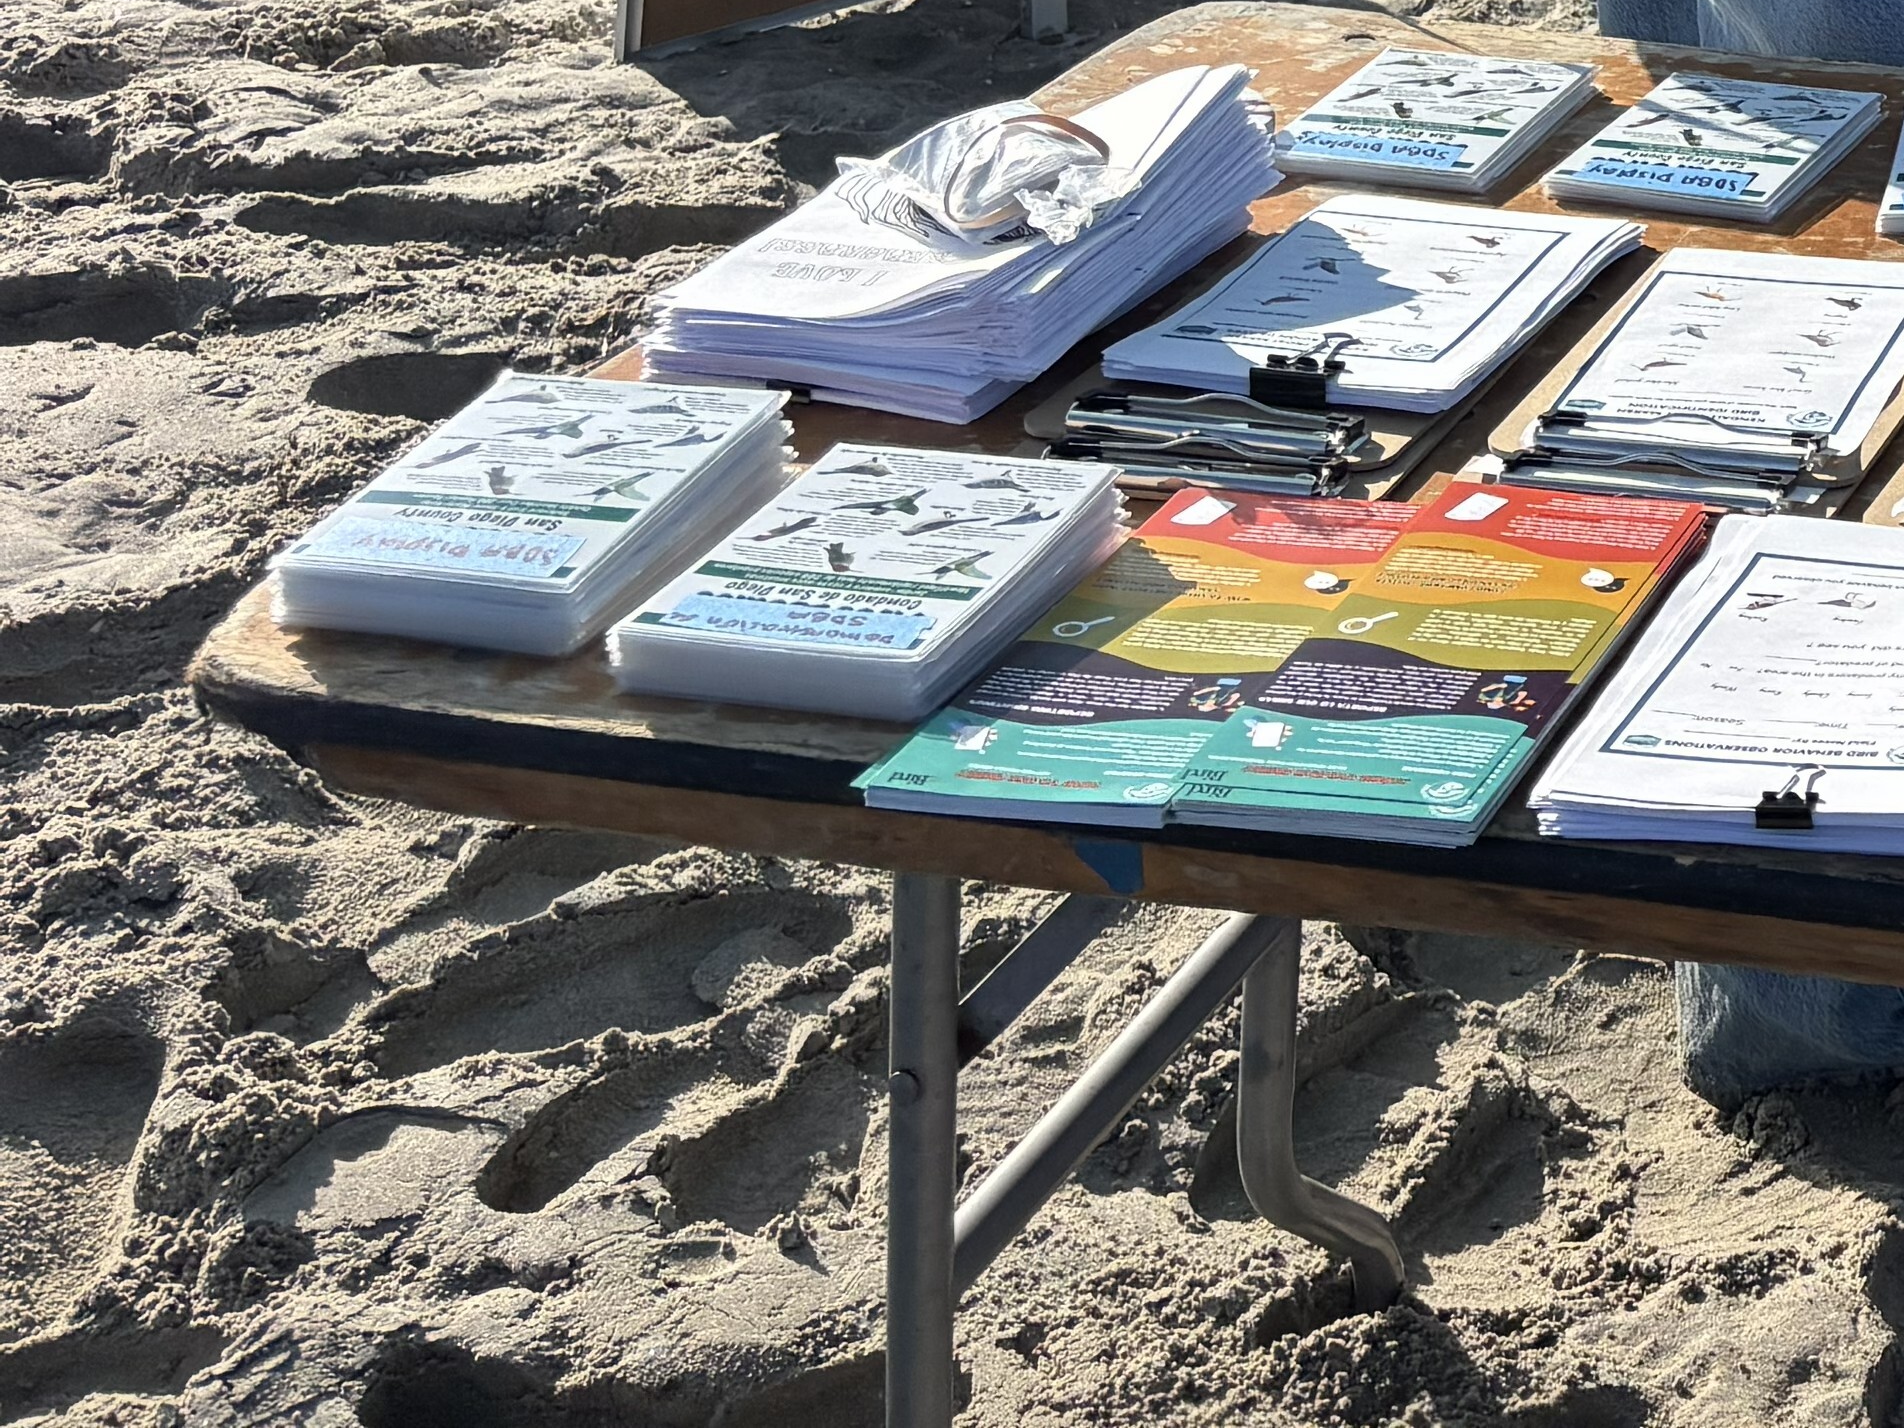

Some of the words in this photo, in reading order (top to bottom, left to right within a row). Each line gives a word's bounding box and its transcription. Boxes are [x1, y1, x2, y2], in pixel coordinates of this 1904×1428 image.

[1429, 132, 1457, 141] San
[1391, 145, 1450, 160] SDBA
[1719, 159, 1746, 169] San
[1681, 176, 1738, 192] SDBA
[771, 262, 862, 282] LOVE
[861, 270, 888, 287] I
[392, 507, 463, 523] County
[467, 512, 521, 528] Diego
[524, 517, 563, 532] San
[723, 580, 776, 596] Diego
[779, 585, 816, 601] San
[819, 590, 841, 602] de
[842, 592, 923, 610] Condado
[1664, 739, 1768, 753] OBSERVATIONS
[1772, 747, 1842, 756] BEHAVIOR
[1846, 750, 1878, 758] BIRD
[887, 770, 930, 787] Bird
